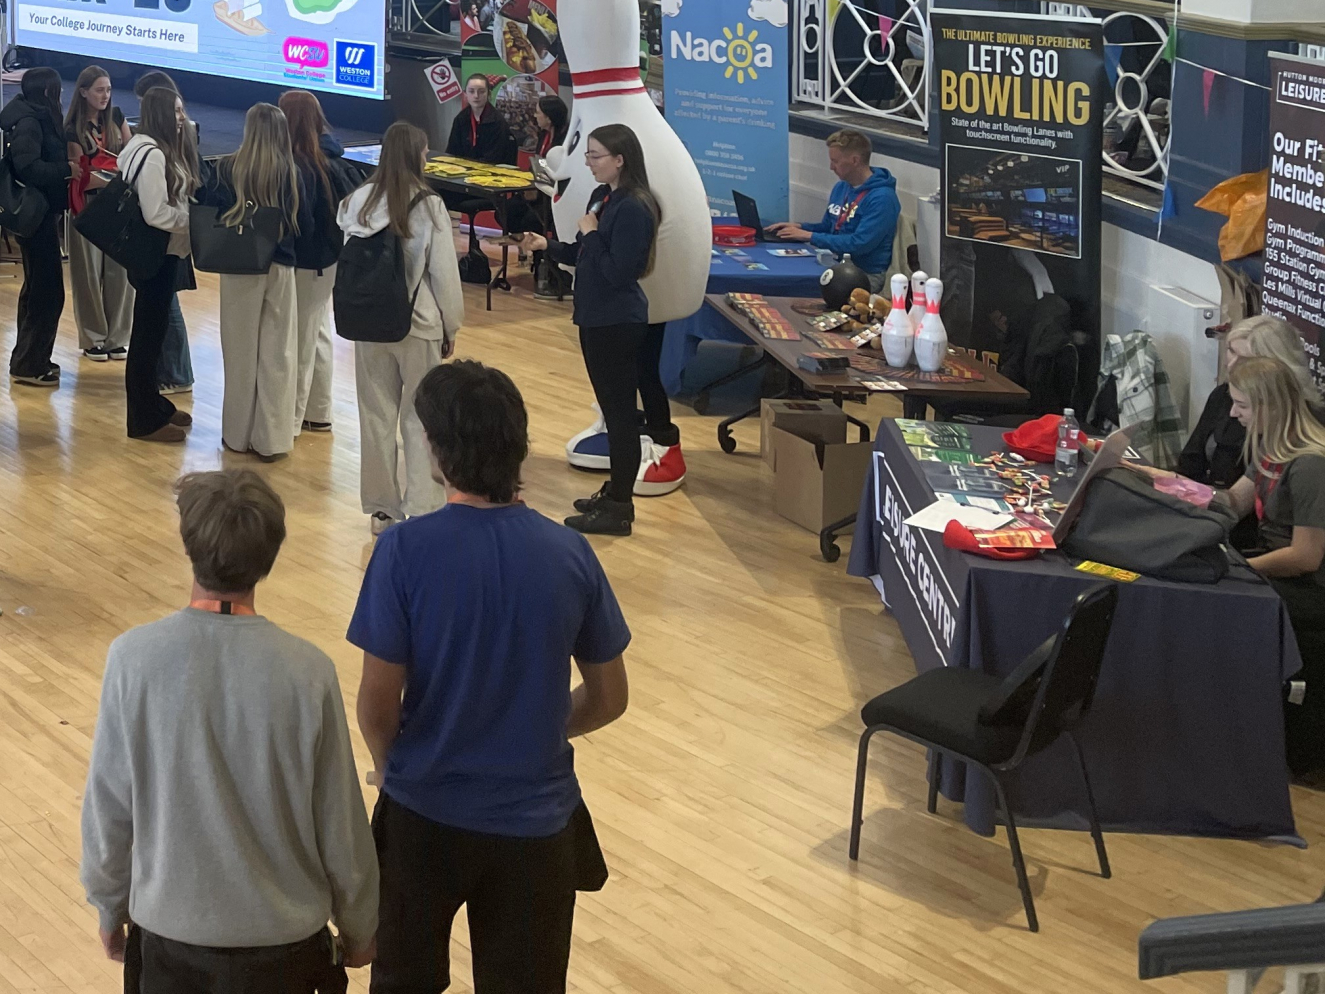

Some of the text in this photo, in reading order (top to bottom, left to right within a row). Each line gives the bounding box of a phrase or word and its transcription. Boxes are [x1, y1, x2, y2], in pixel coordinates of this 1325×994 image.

[29, 13, 185, 43] Your College Journey Starts Here
[941, 28, 1092, 50] THE ULTIMATE BOWLING EXPERIENCE
[671, 30, 773, 68] Nacoa
[968, 43, 1059, 79] LET'S GO
[339, 66, 371, 76] WESTON
[339, 74, 370, 84] COLLEGE
[674, 88, 706, 99] Providing
[941, 69, 1091, 126] BOWLING
[1281, 81, 1325, 104] LEISURE
[695, 102, 722, 111] support
[735, 107, 767, 116] everyone
[951, 116, 1074, 139] State of the art Bowling Lanes with
[966, 128, 1057, 149] touchscreen functionality.
[1273, 132, 1301, 156] Our
[1055, 164, 1071, 174] VIP
[1272, 155, 1324, 188] Membe
[1267, 218, 1325, 248] Gym Induction
[1265, 247, 1278, 262] 155
[1280, 252, 1307, 273] Station
[1266, 233, 1325, 263] Gym Programm
[1264, 261, 1289, 282] Group
[1291, 271, 1316, 293] Fitness
[1263, 276, 1322, 309] Les Mills Virtual
[1262, 290, 1325, 329] Queenax Functio
[883, 484, 917, 576] EISURE
